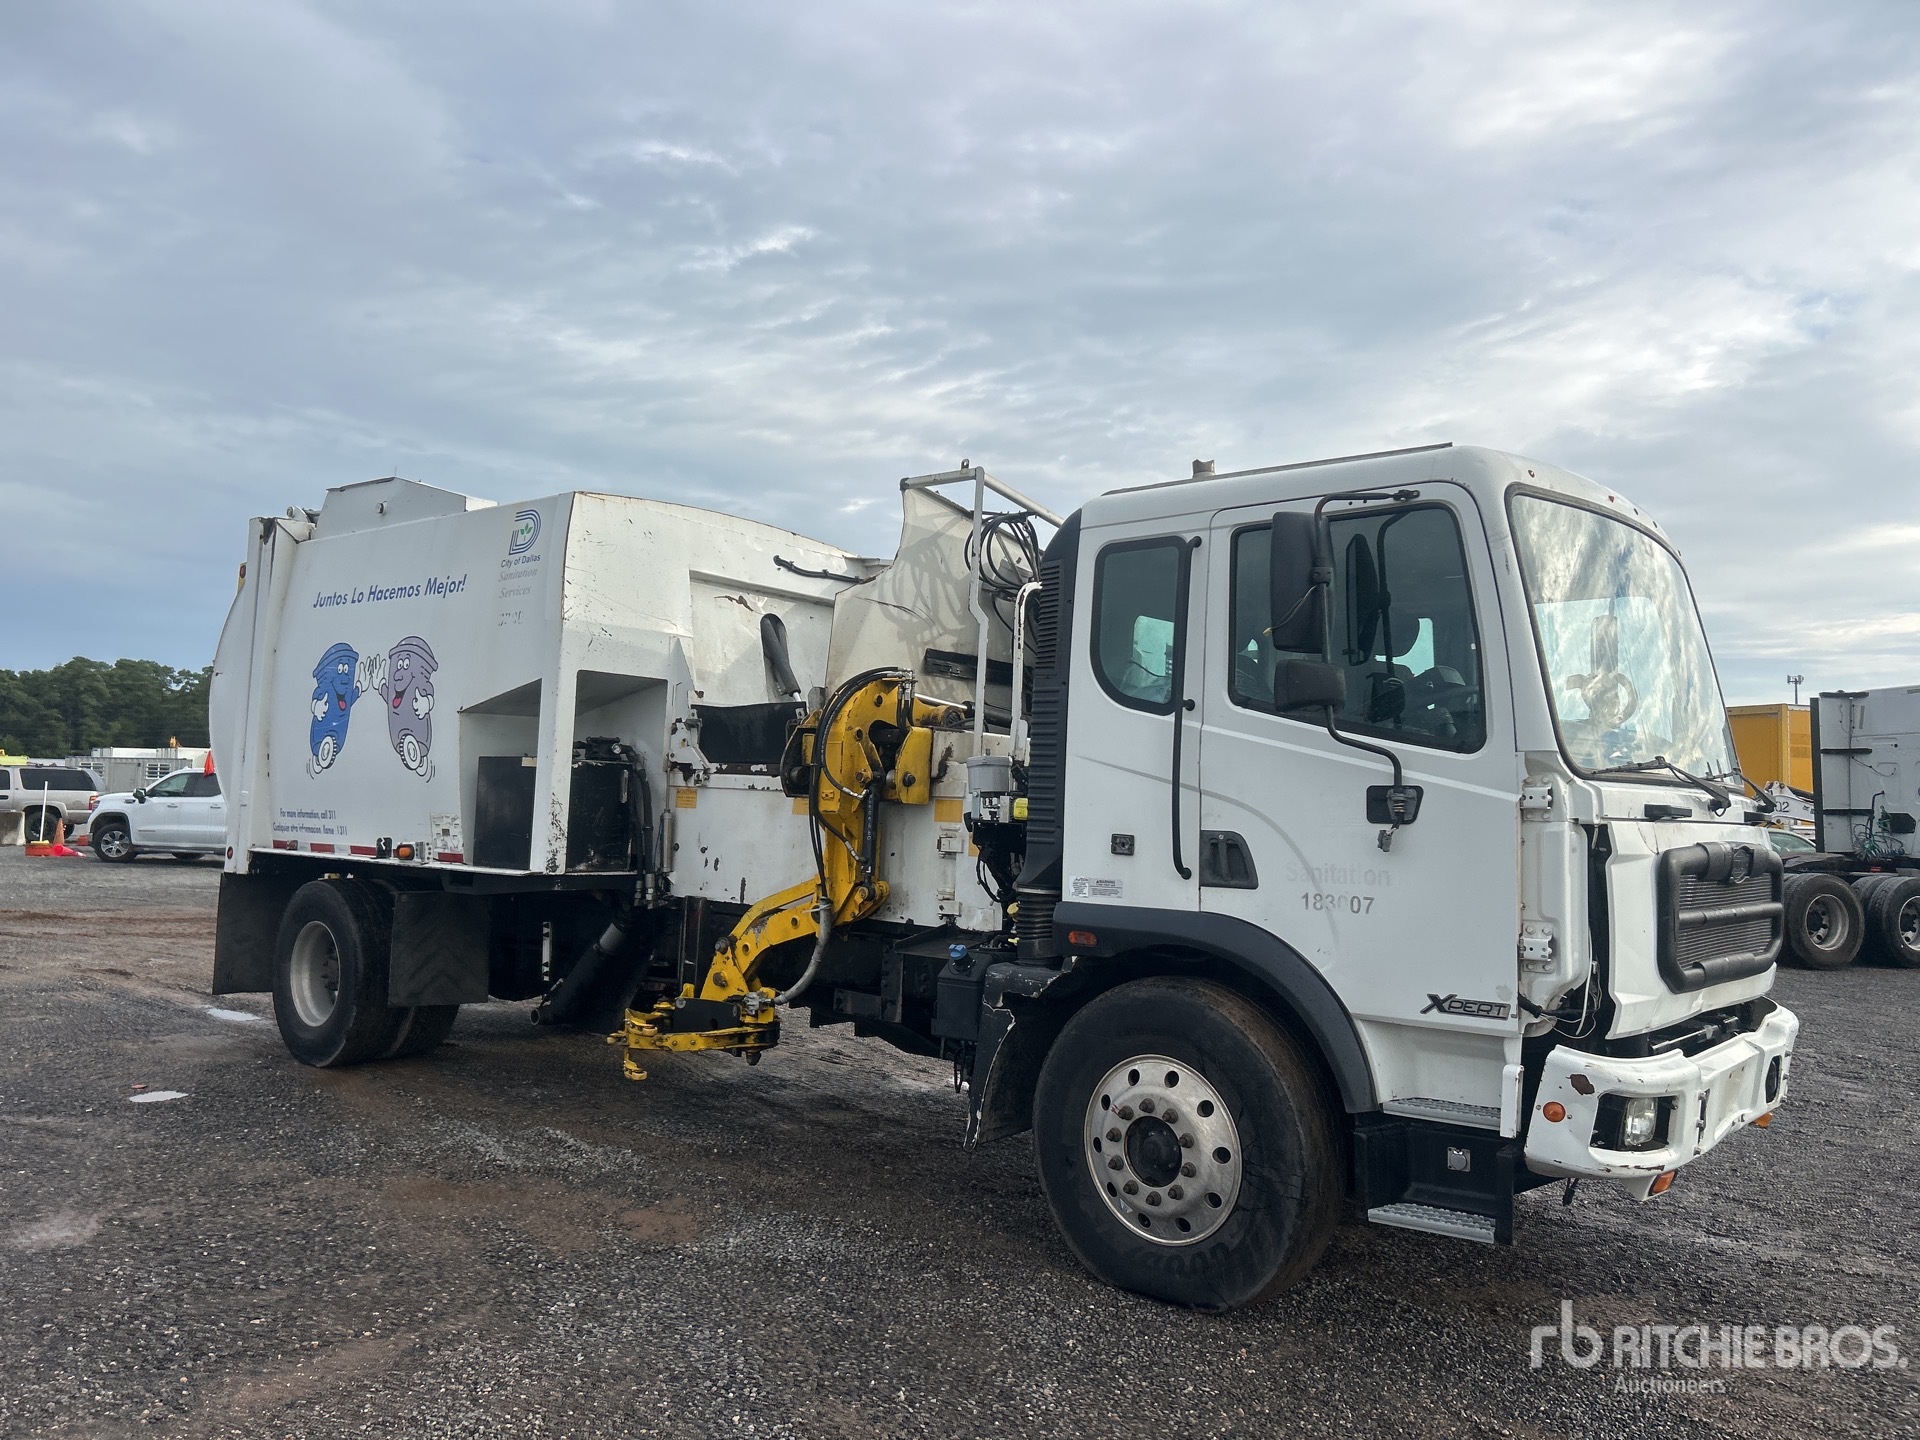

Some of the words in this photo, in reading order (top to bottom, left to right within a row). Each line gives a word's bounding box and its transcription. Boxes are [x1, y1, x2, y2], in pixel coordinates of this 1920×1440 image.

[501, 559, 512, 568] City
[514, 556, 521, 566] of
[522, 554, 541, 564] Dallas
[499, 567, 538, 582] Sanitation
[313, 591, 349, 609] Juntos
[351, 587, 365, 604] Lo
[367, 584, 421, 602] Hacemos
[424, 573, 468, 599] Mejor!
[499, 585, 532, 599] Services
[328, 810, 336, 819] 311
[1419, 993, 1511, 1021] XPERT
